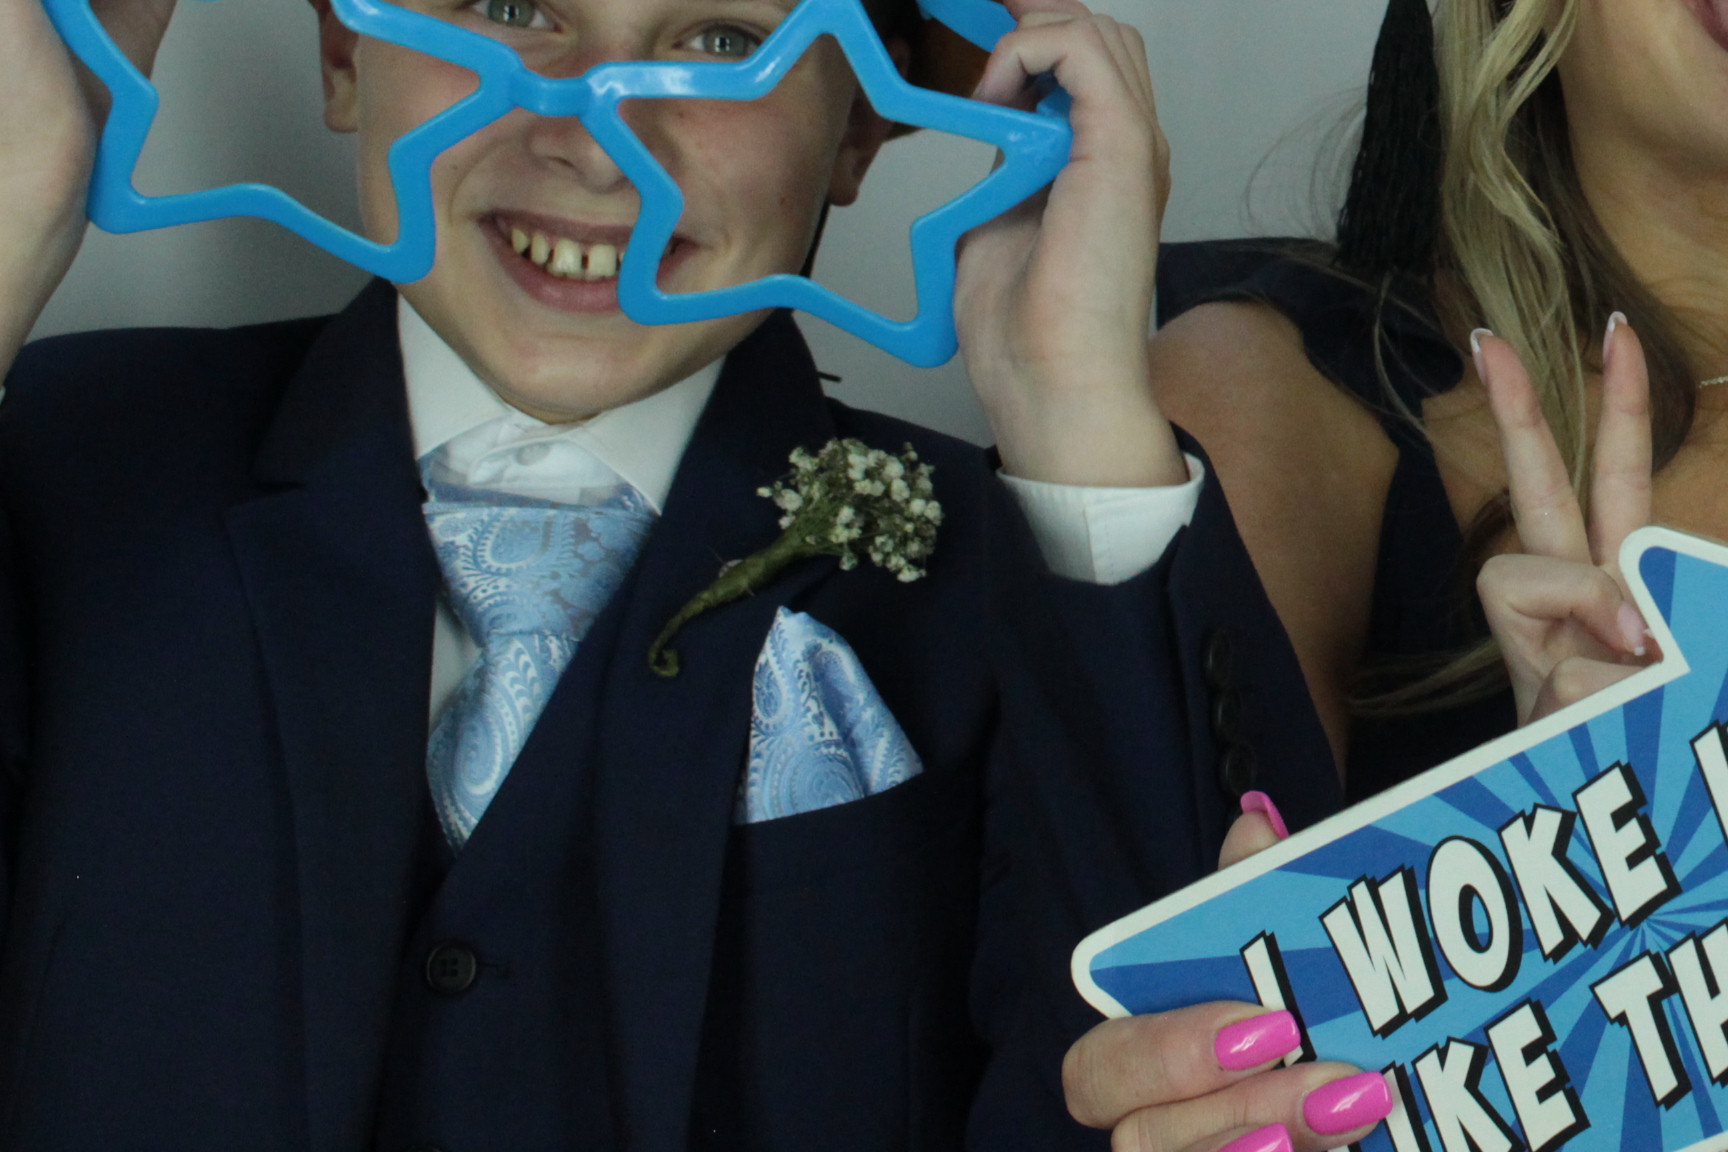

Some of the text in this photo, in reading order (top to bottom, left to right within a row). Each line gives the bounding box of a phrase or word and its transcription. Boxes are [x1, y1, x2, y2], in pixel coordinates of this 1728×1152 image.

[1240, 930, 1318, 1067] I
[1319, 760, 1682, 1039] WOKE
[1323, 997, 1591, 1152] IKE
